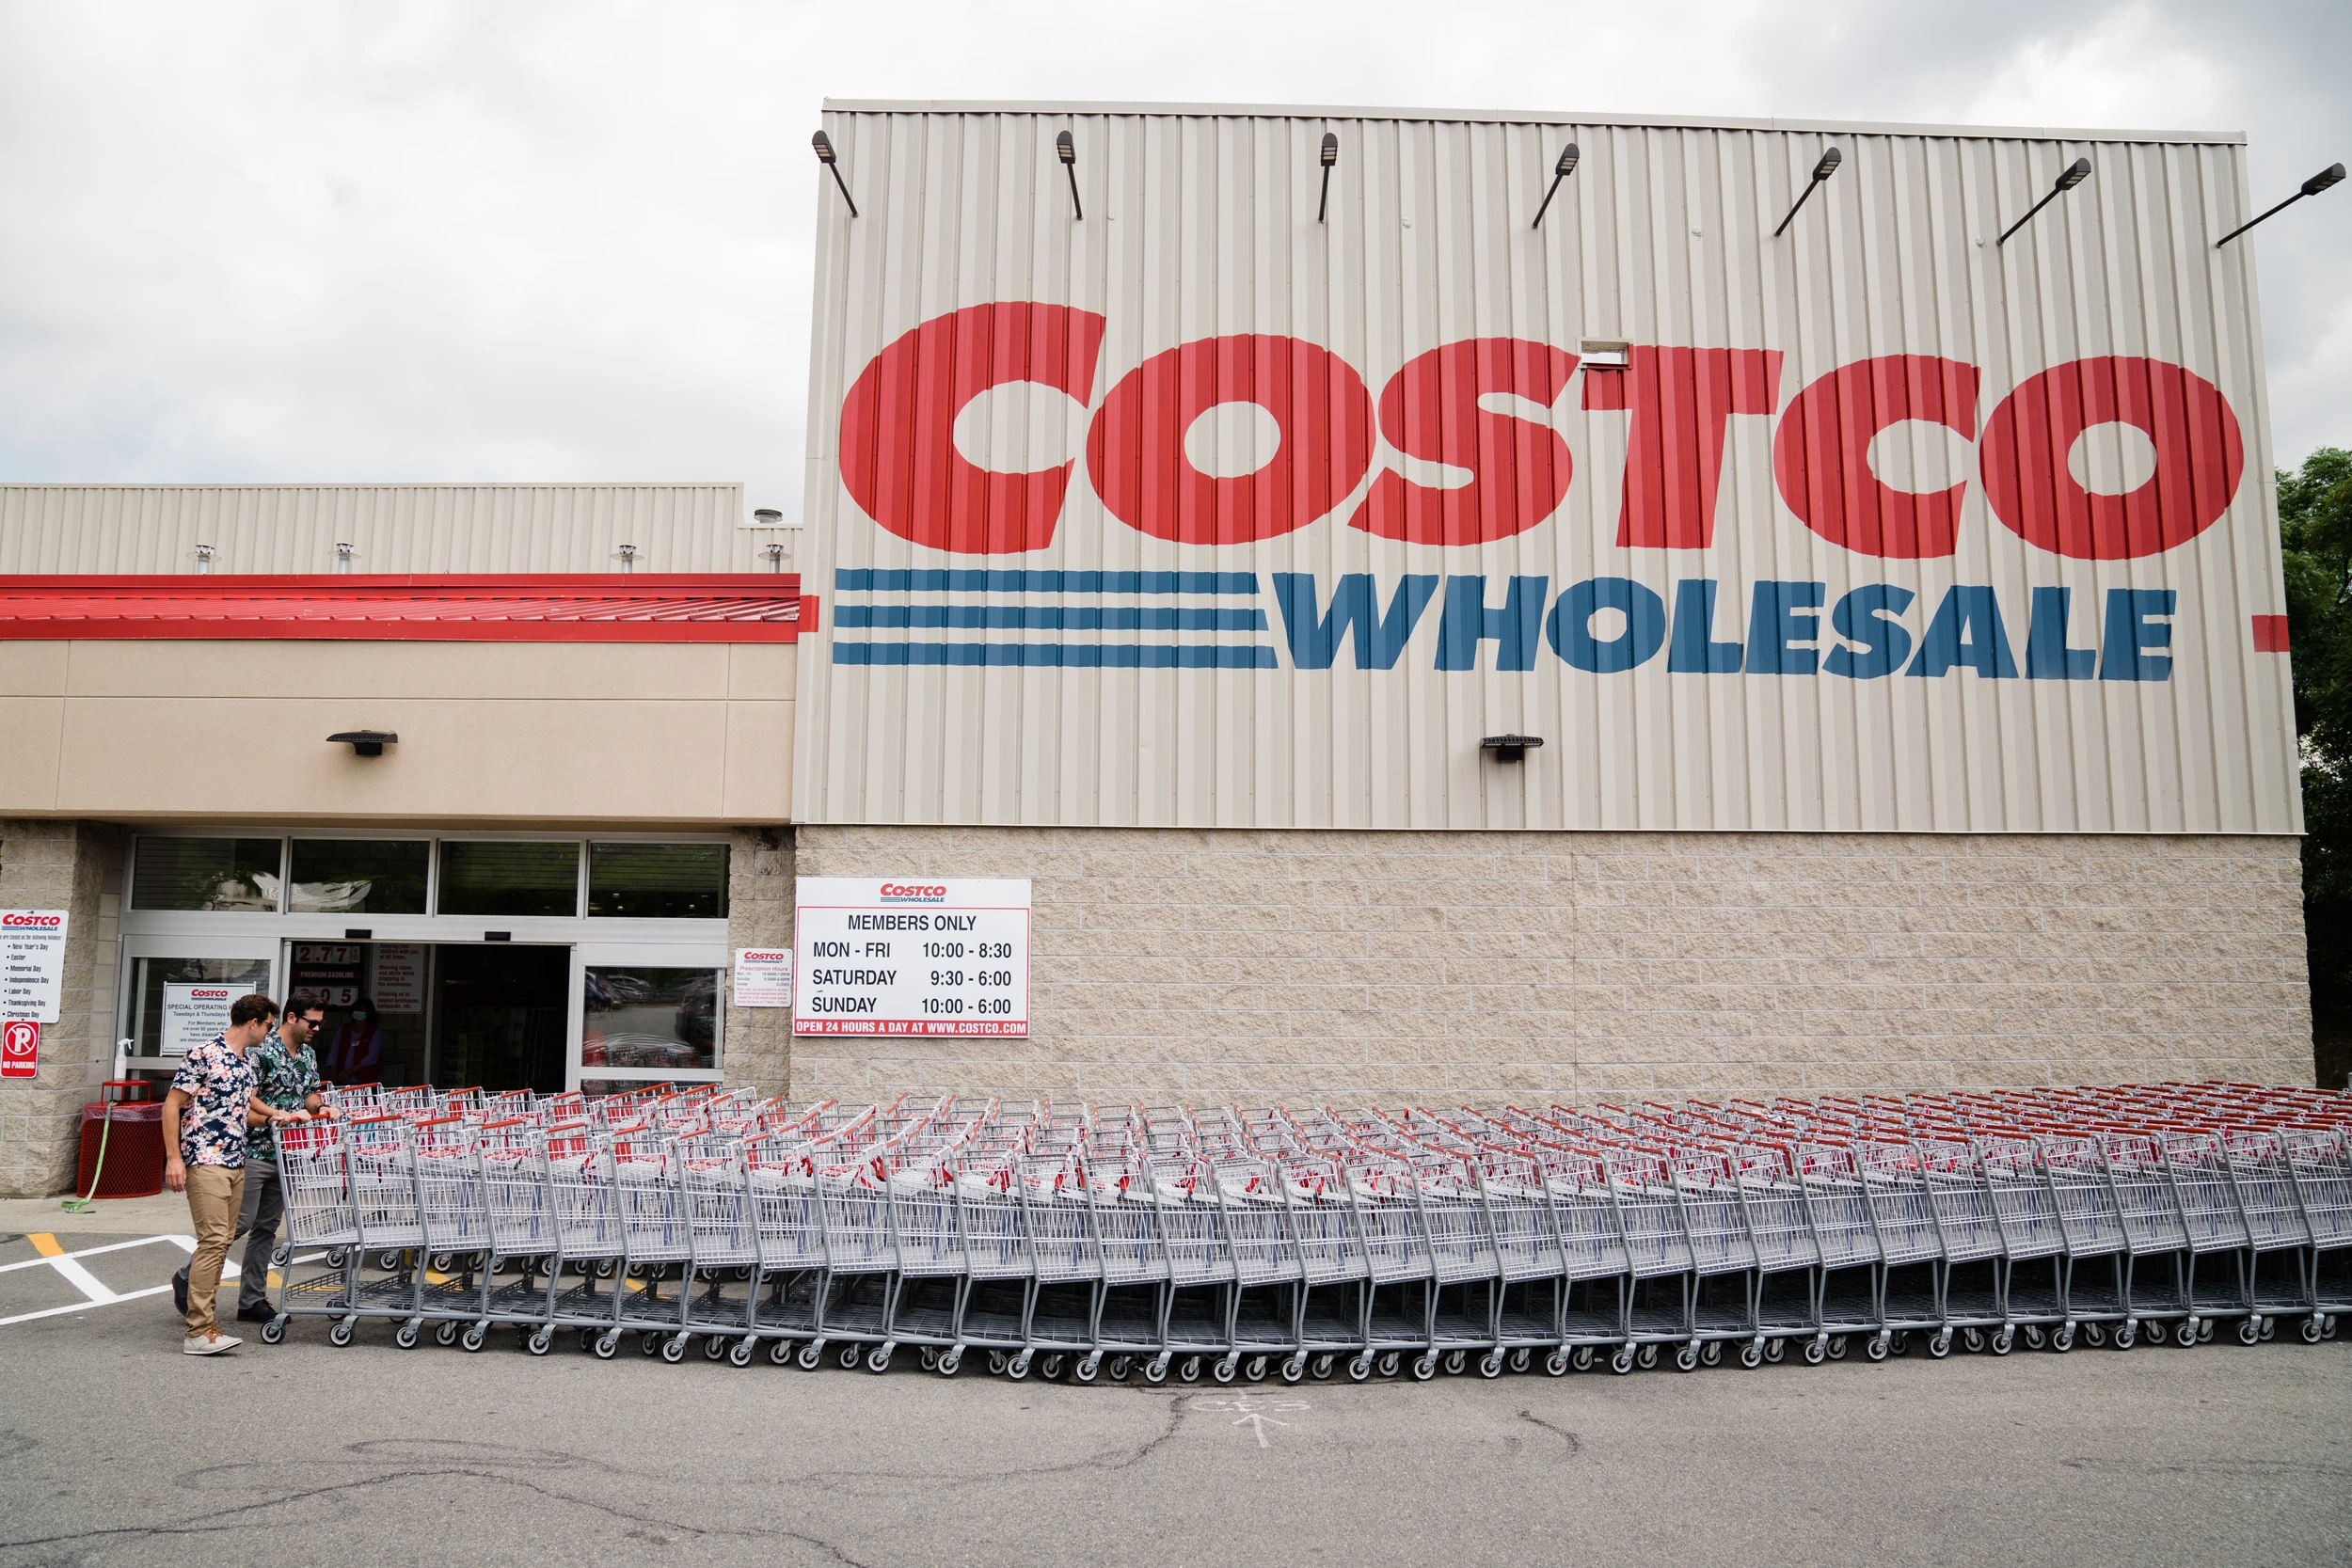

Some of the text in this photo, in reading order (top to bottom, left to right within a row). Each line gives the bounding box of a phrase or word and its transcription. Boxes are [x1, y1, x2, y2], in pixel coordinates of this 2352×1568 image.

[839, 301, 2245, 561] COSTCO
[1272, 573, 2177, 682] WHOLESALE
[881, 883, 946, 896] COSTCO
[3, 914, 60, 926] COSTCO
[848, 915, 977, 931] MEMBERS ONLY
[744, 951, 784, 959] COSTCO
[814, 942, 850, 958] MON
[866, 942, 890, 958] FRI
[923, 942, 964, 958] 10:00
[978, 942, 1012, 958] 8:30
[813, 969, 897, 985] SATURDAY
[930, 971, 963, 986] 9:30
[978, 971, 1011, 986] 6:00
[191, 989, 228, 997] COSTCO
[812, 997, 877, 1012] SUNDAY
[922, 998, 963, 1014] 10:00
[978, 999, 1011, 1014] 6:00
[796, 1022, 1026, 1034] OPEN 24 HOURS A DAY AT WWW.COSTCO.COM
